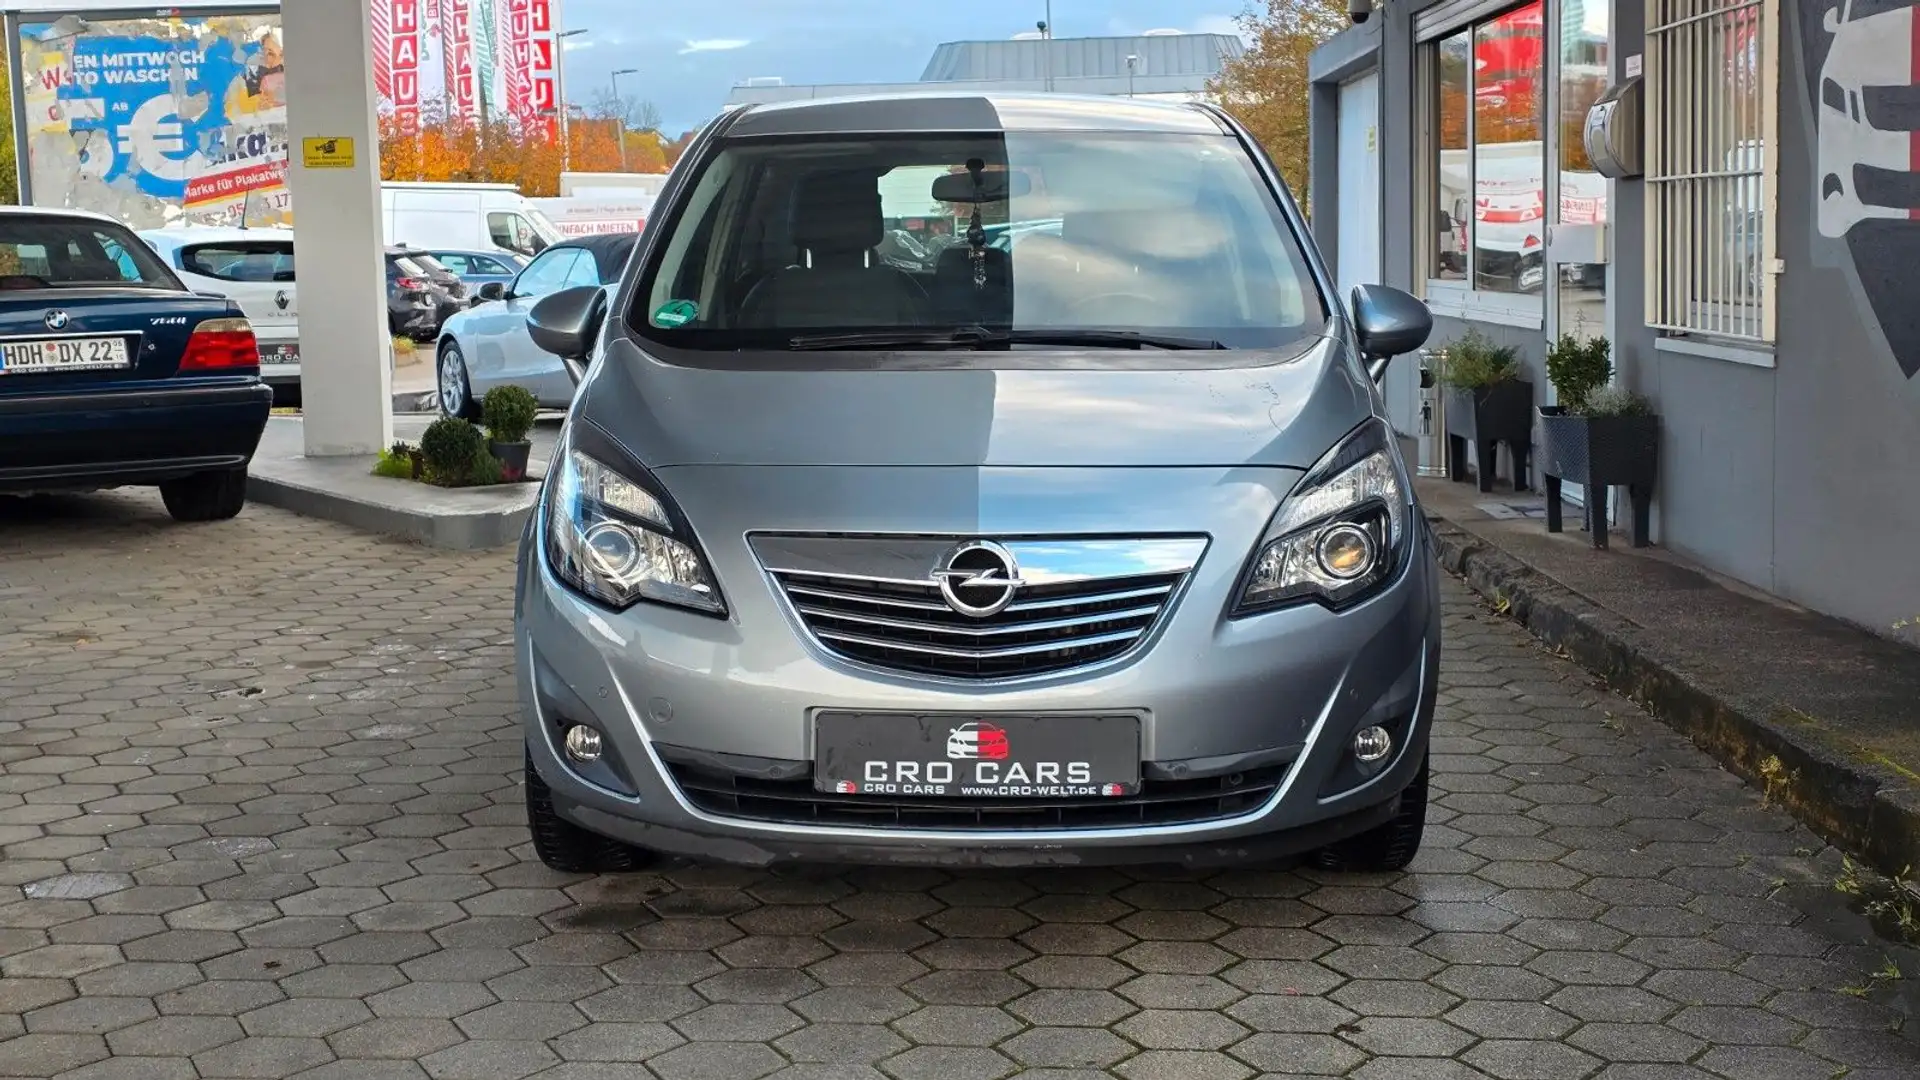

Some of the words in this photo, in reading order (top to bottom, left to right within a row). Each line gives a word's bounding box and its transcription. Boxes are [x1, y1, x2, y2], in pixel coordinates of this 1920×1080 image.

[103, 51, 206, 67] MITTWOCH
[103, 68, 198, 84] WASCHN
[112, 102, 128, 111] AB
[216, 177, 233, 190] für
[4, 345, 43, 366] HDH
[58, 343, 84, 362] DX
[89, 342, 112, 360] 22
[864, 761, 952, 784] CRO
[975, 761, 1091, 784] CARS
[864, 784, 896, 793] CRO
[903, 784, 945, 794] CARS
